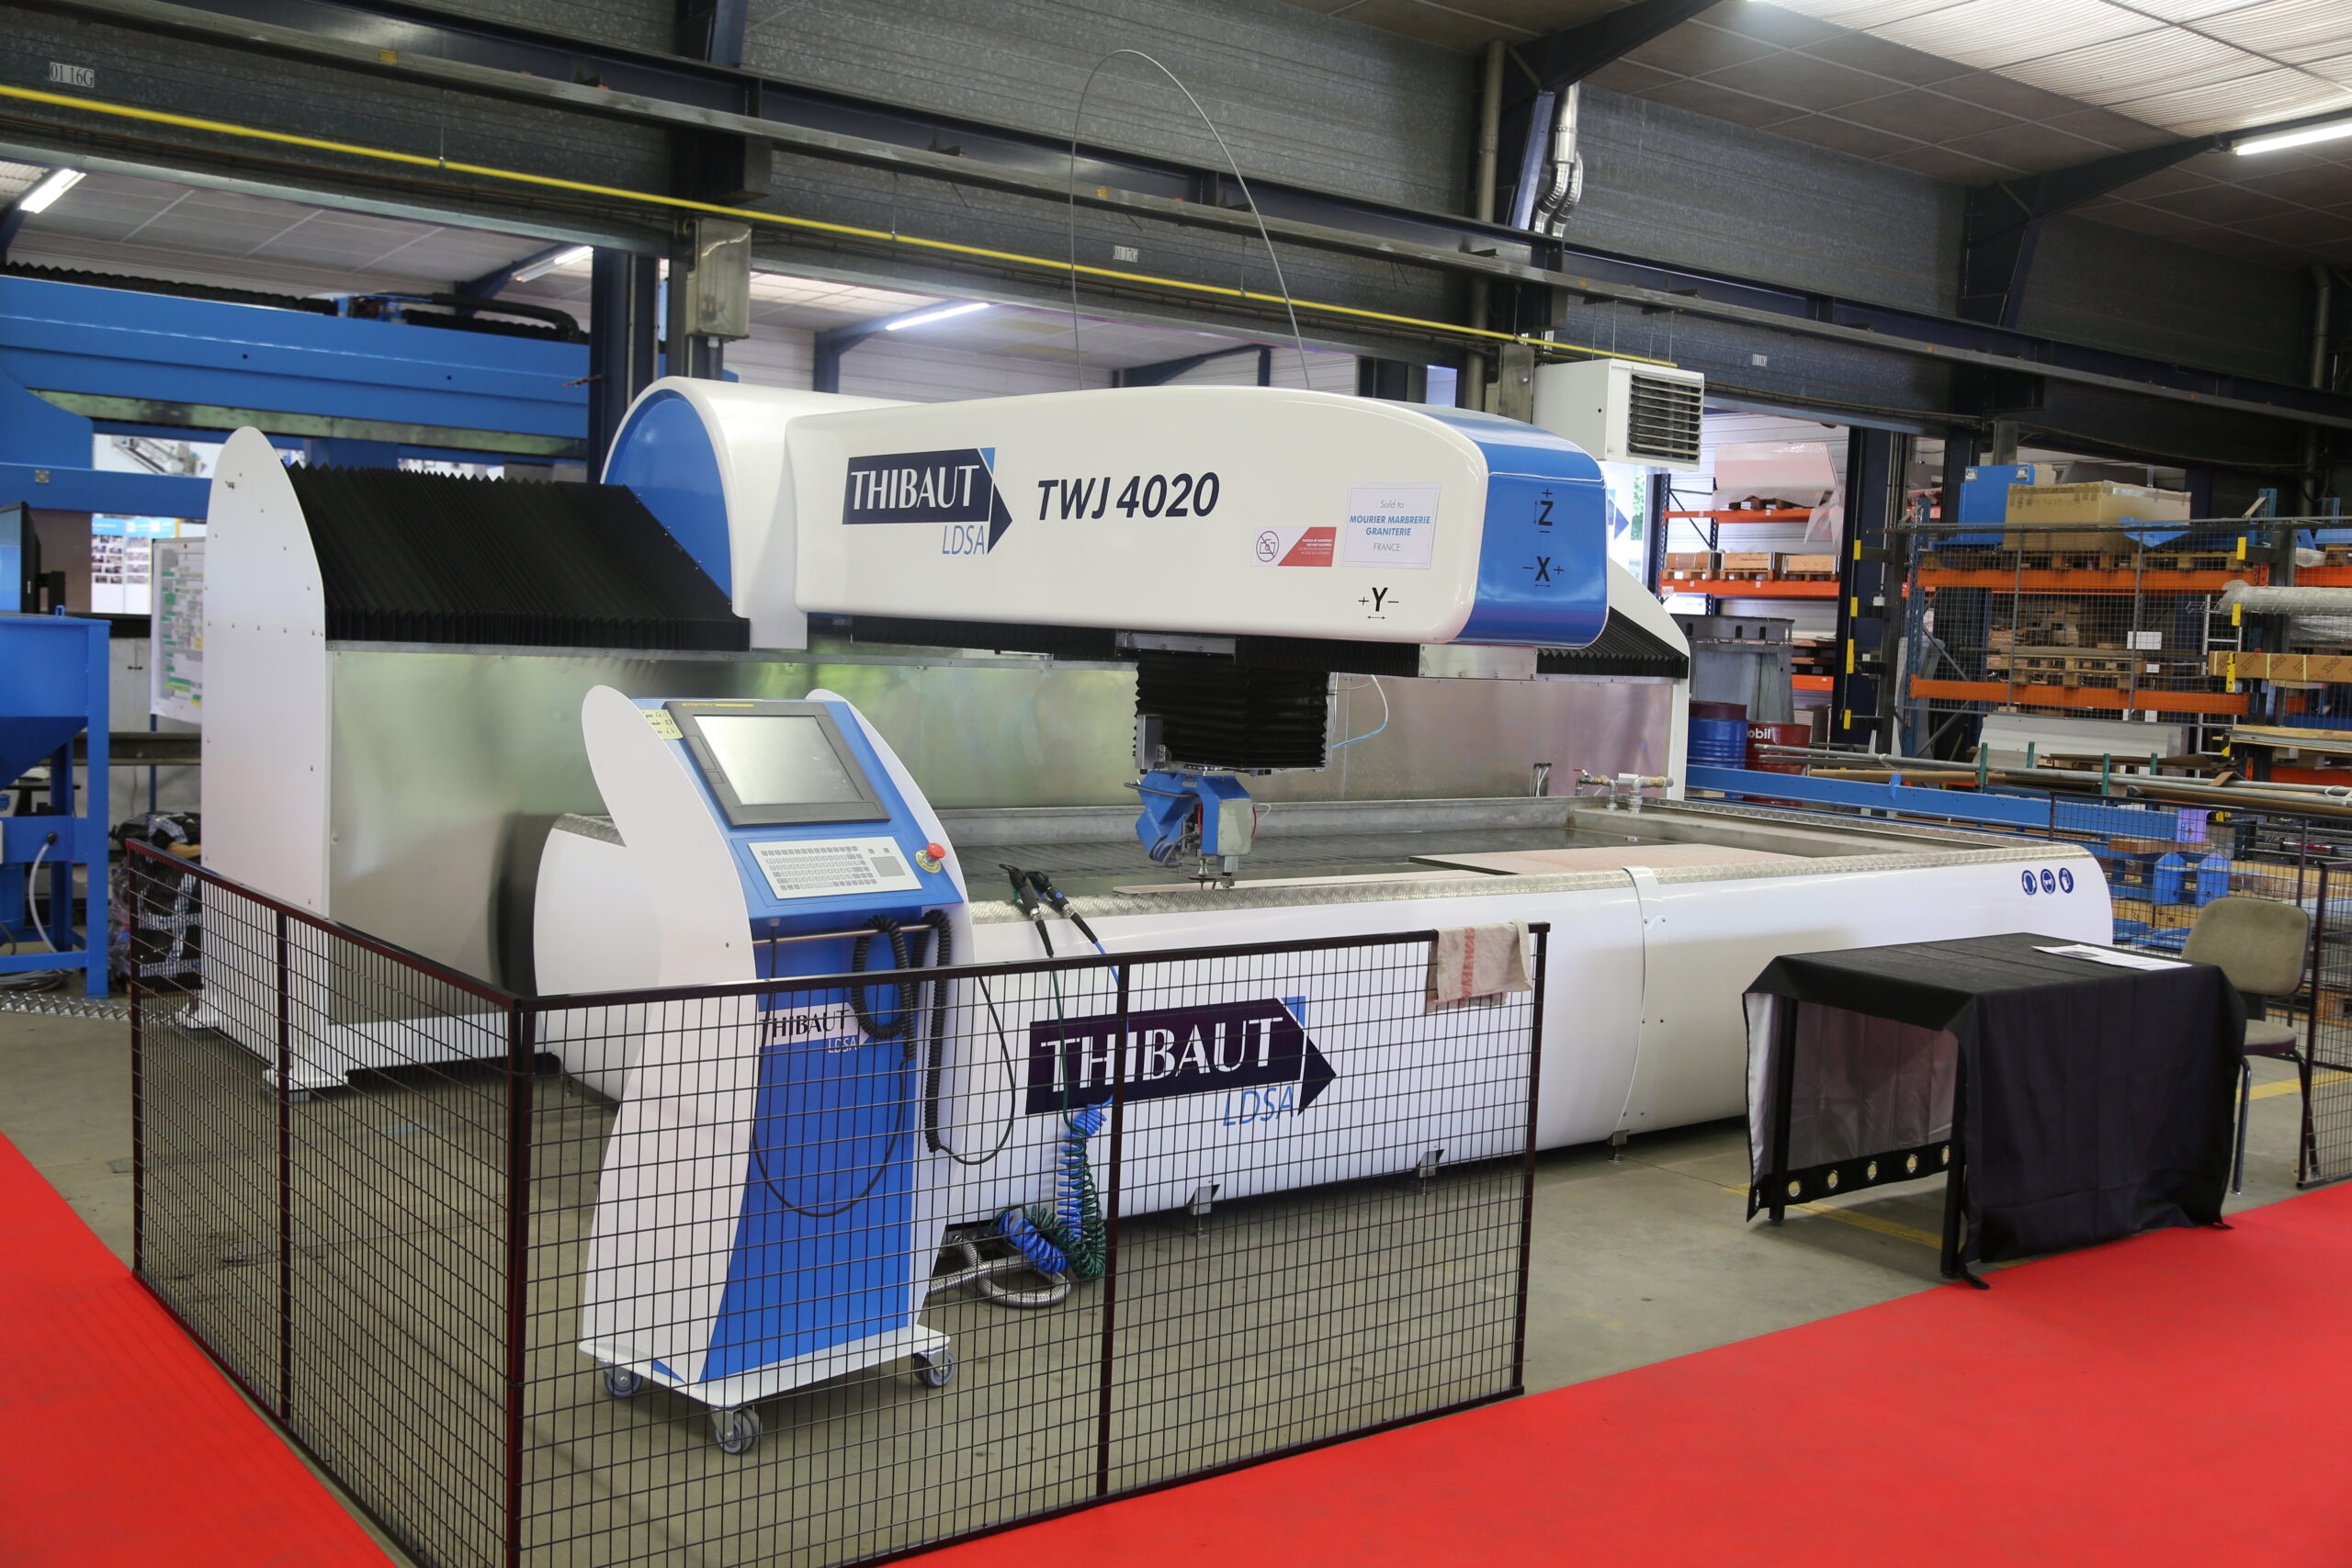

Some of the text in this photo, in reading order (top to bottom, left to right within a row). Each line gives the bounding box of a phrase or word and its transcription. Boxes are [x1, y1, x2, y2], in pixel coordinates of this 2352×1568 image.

[71, 66, 94, 86] 16G
[851, 464, 980, 511] THIBAUT
[1037, 471, 1221, 521] TWJ 4020
[1380, 500, 1396, 509] Sold
[1350, 515, 1430, 525] MOURIER MARBRERIE
[942, 525, 986, 555] LDSA
[1365, 527, 1411, 536] GRANITERIE
[1374, 543, 1401, 551] FRANCE
[1746, 728, 1771, 739] obil
[759, 1010, 850, 1037] THIBAUT
[828, 1036, 857, 1054] LDSA
[1041, 1017, 1283, 1092] THIBAUT
[1223, 1085, 1295, 1126] LDSA
